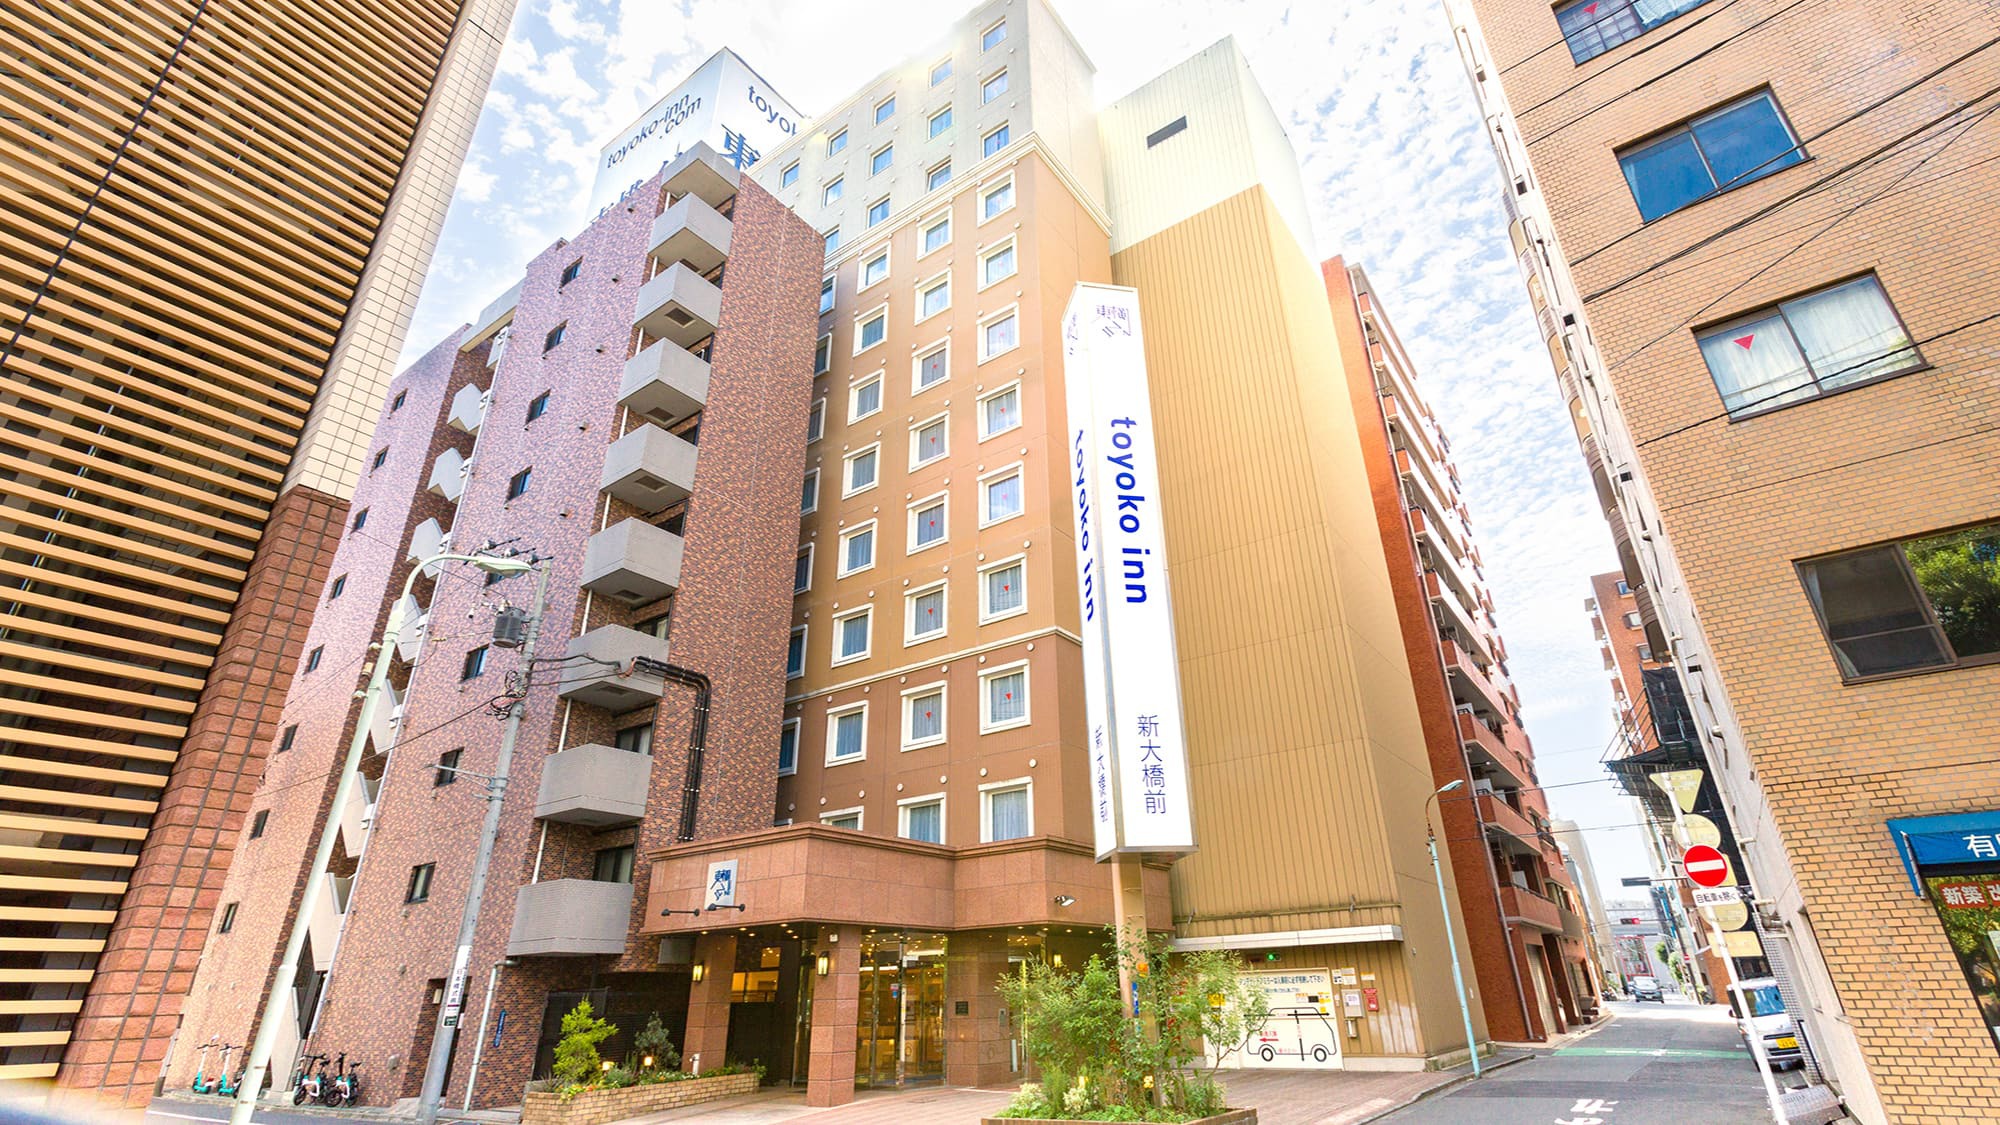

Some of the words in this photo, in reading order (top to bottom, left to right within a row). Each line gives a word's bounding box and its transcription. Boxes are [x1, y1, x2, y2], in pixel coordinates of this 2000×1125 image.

[606, 94, 690, 169] toyoko-inn
[1107, 416, 1146, 533] toyoko
[1122, 548, 1151, 604] inn
[1137, 714, 1167, 815] 新大橋前
[1962, 833, 2000, 858] 有
[1942, 885, 1985, 905] 新築
